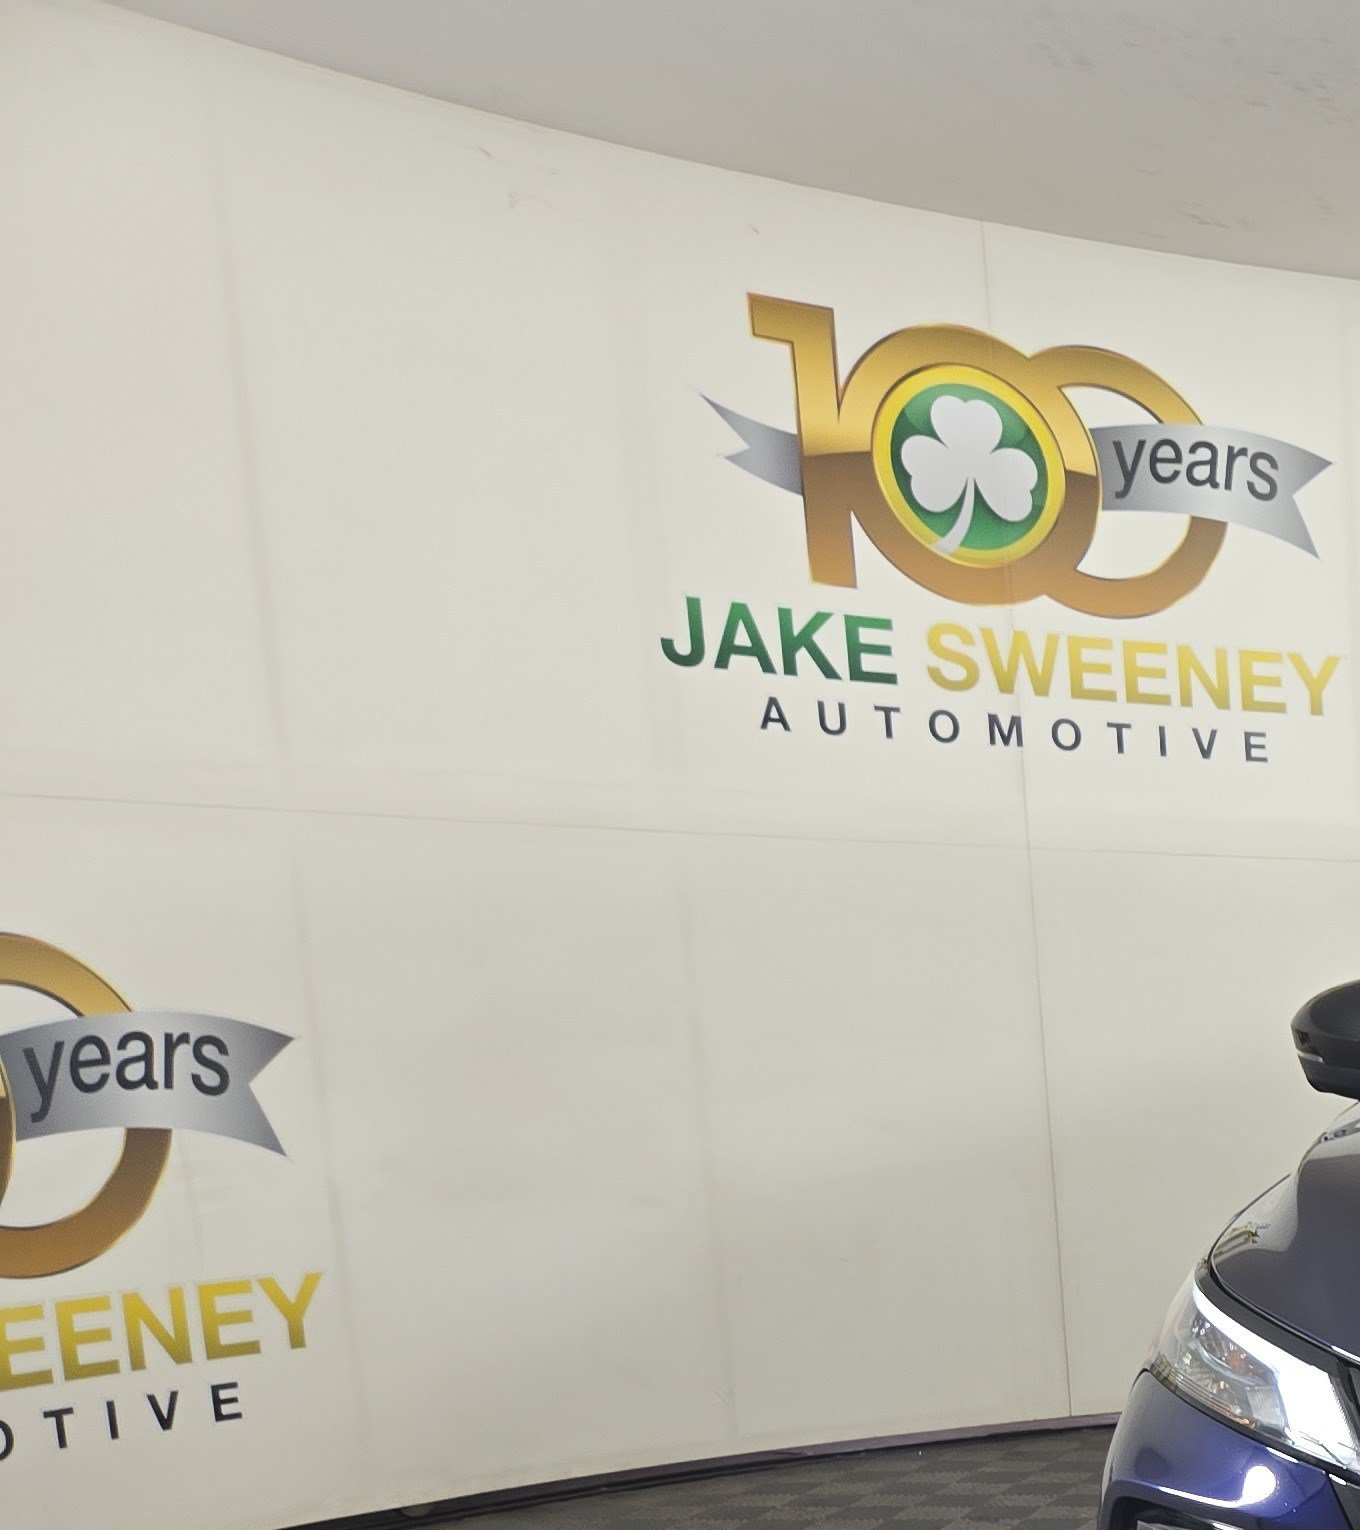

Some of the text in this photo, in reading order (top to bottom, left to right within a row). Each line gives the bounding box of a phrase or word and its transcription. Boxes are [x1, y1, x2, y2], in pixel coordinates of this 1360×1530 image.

[746, 292, 1228, 619] 100
[1112, 436, 1280, 501] years
[660, 596, 1342, 717] JAKE SWEENEY
[760, 696, 1269, 763] AUTOMOTIVE
[23, 1030, 231, 1123] years
